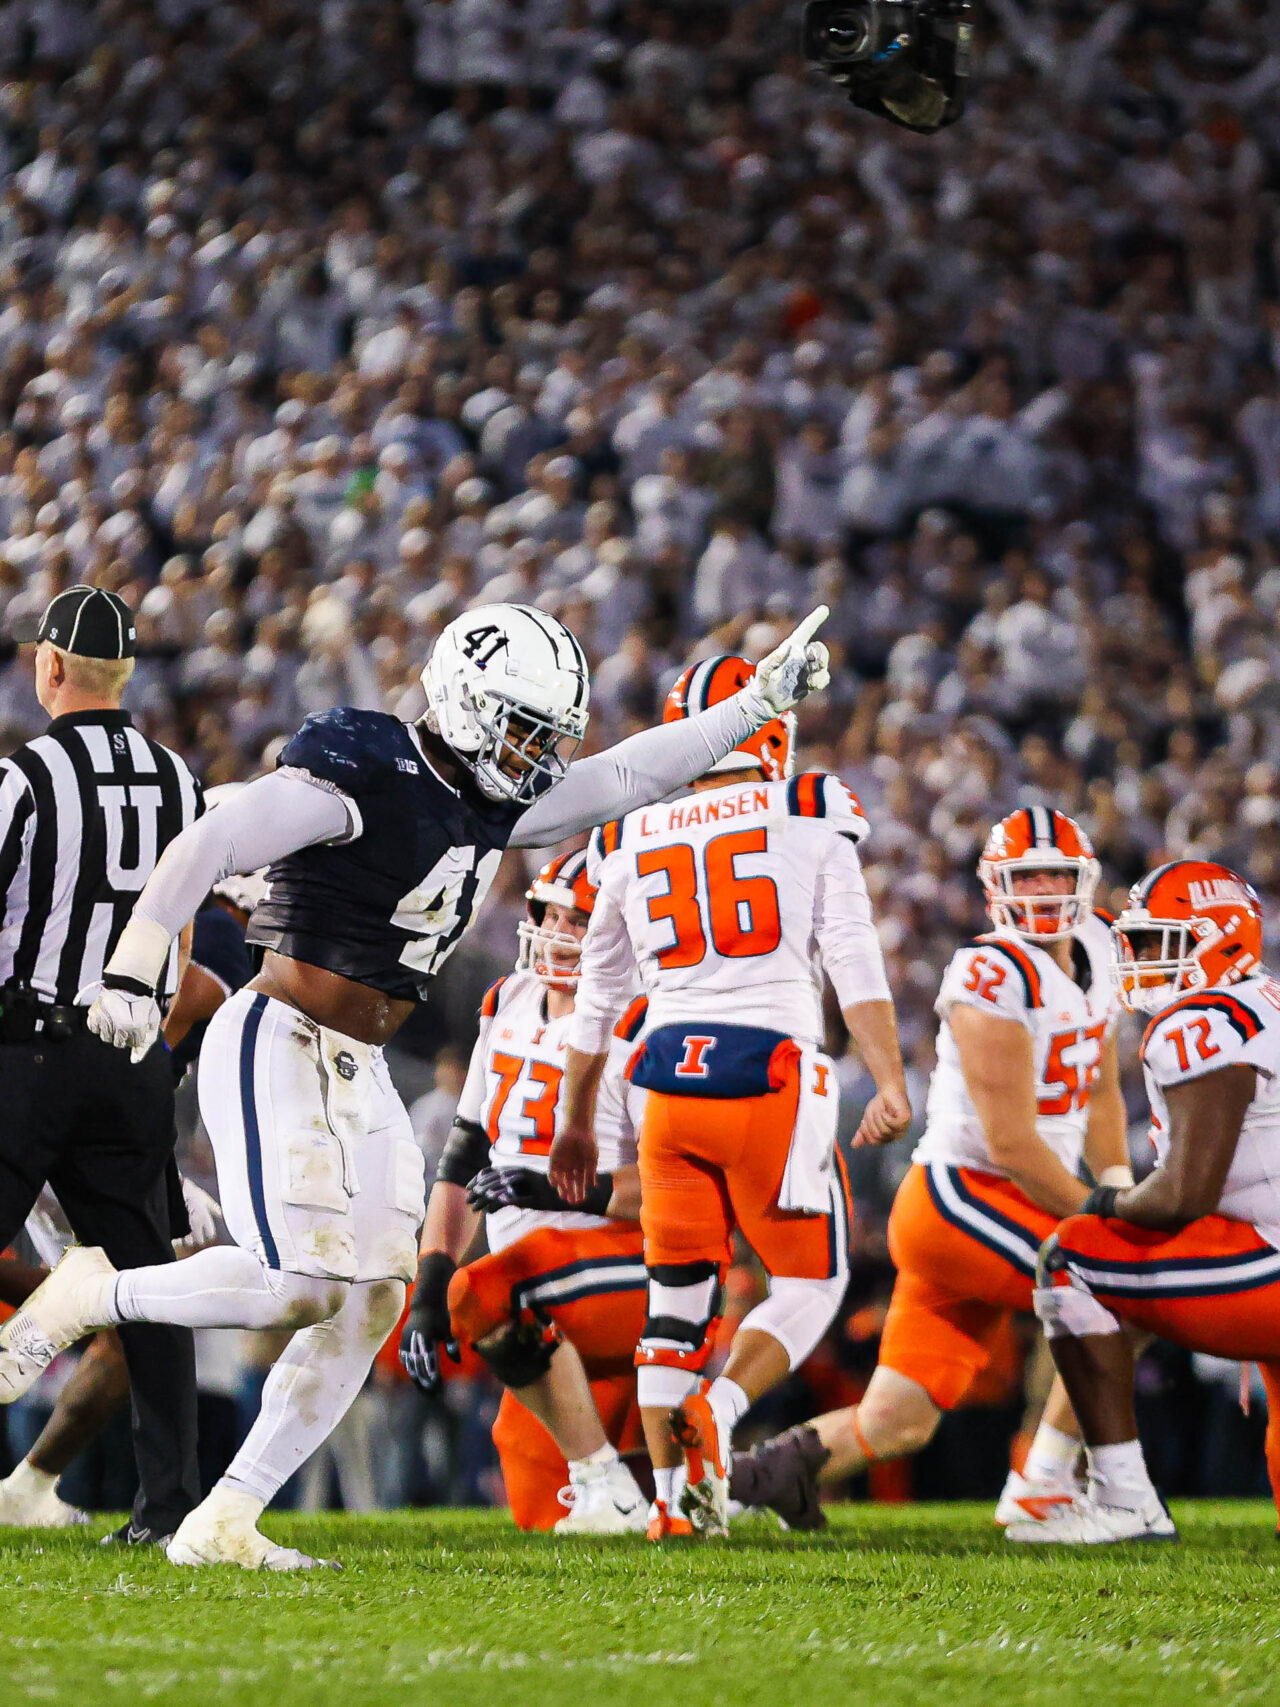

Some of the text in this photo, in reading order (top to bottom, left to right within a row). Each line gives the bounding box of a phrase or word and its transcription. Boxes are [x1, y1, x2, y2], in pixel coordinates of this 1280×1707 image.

[462, 625, 510, 671] 41
[96, 785, 163, 891] U
[640, 787, 769, 837] L. HANSEN
[389, 845, 503, 976] 41
[635, 826, 782, 970] 36
[964, 955, 1007, 1003] 52
[675, 1035, 718, 1078] I
[1164, 1016, 1221, 1072] 72
[486, 1050, 564, 1156] 73
